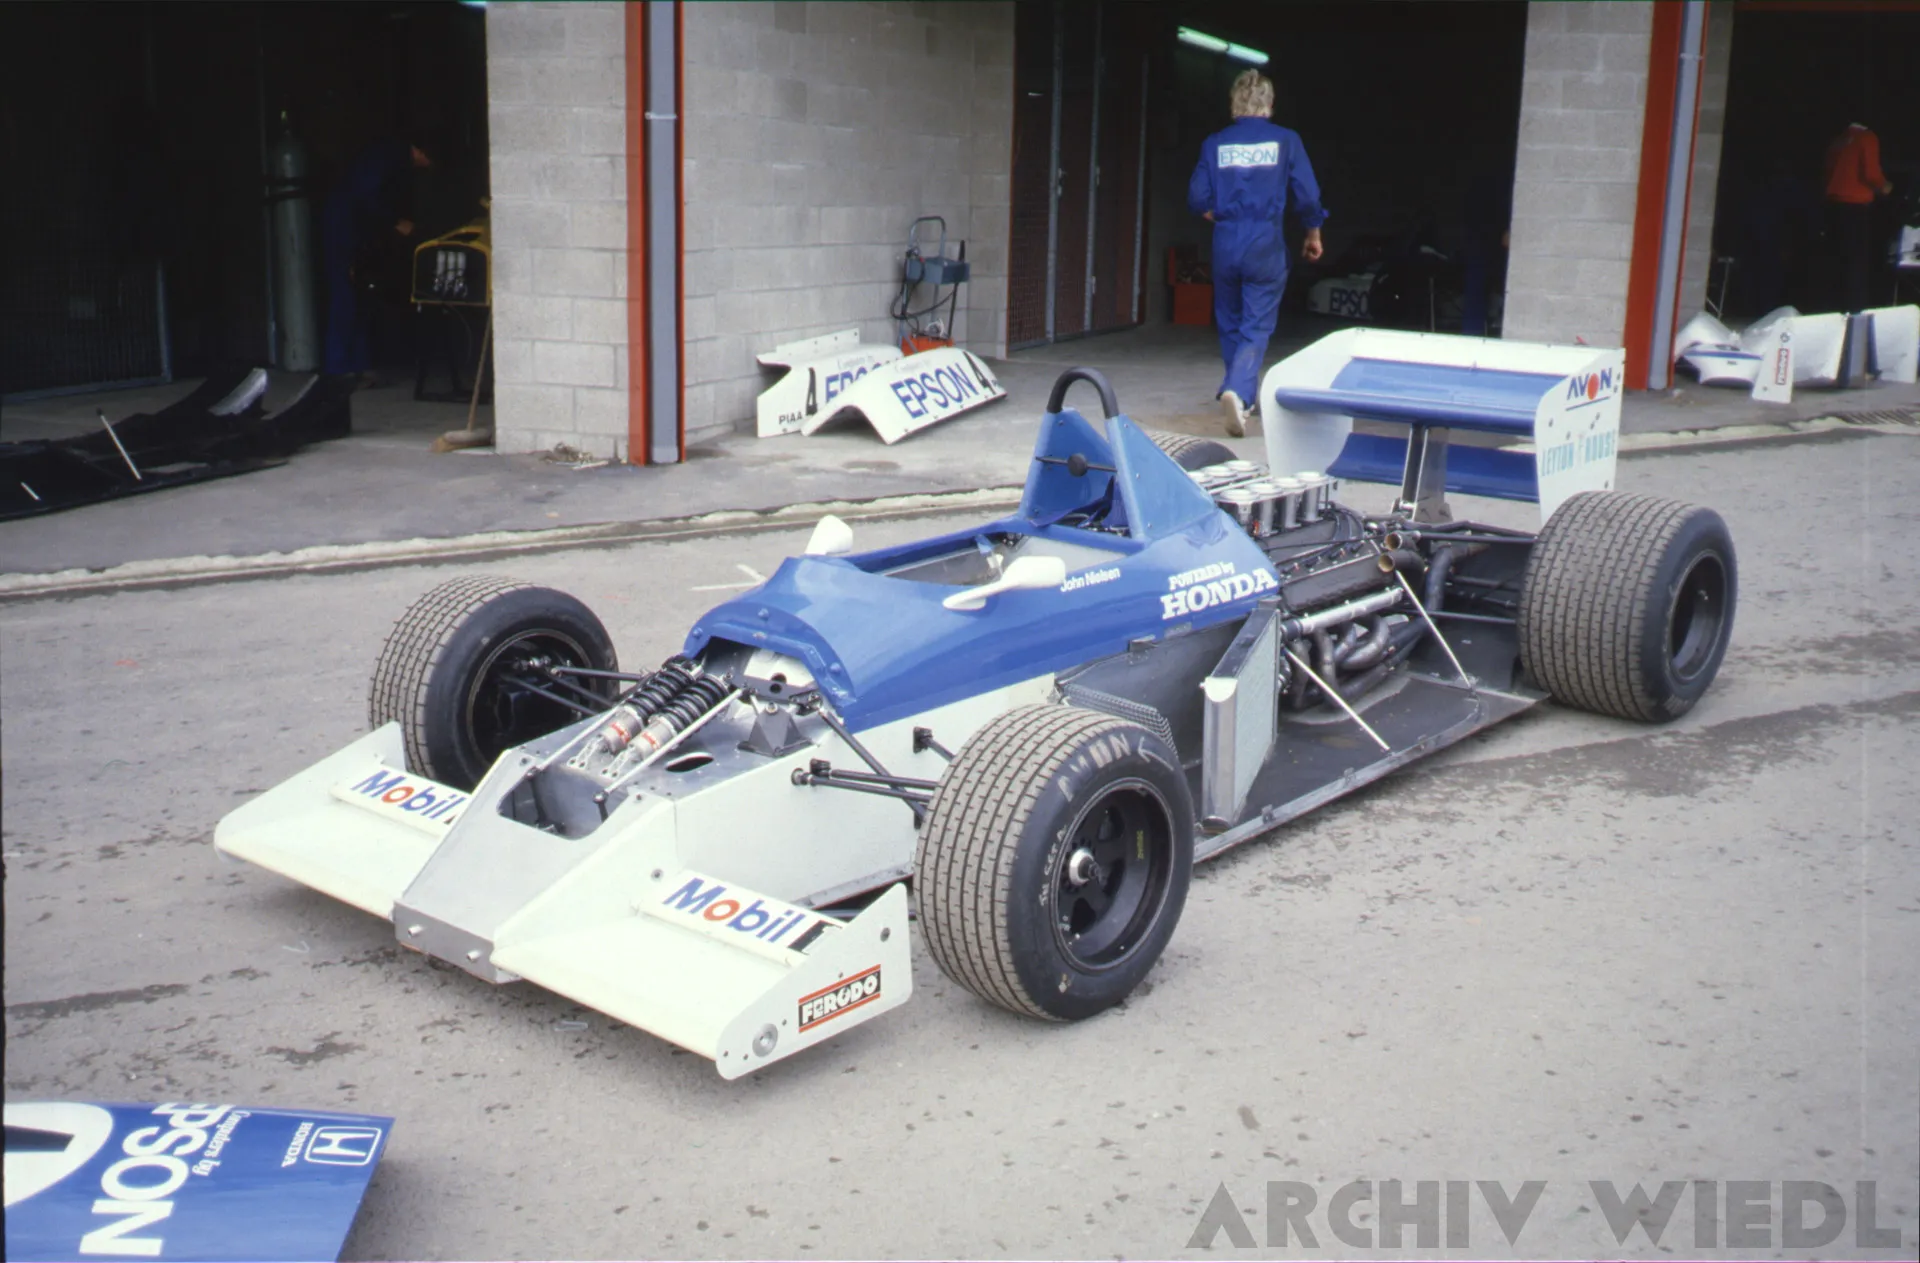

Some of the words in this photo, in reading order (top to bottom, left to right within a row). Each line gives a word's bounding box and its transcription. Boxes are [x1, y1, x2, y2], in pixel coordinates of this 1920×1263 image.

[1219, 148, 1277, 165] EPSON
[1330, 287, 1370, 318] EPSO
[889, 362, 980, 420] EPSON
[1566, 366, 1613, 401] AVON
[778, 411, 803, 425] PIAA
[1060, 575, 1085, 593] John
[1159, 567, 1278, 620] HONDA
[350, 769, 468, 820] Mobil
[661, 876, 807, 944] Mobil
[801, 973, 879, 1025] FERODO
[203, 1109, 252, 1158] Computers
[281, 1121, 315, 1168] HONDA
[191, 1157, 222, 1177] by
